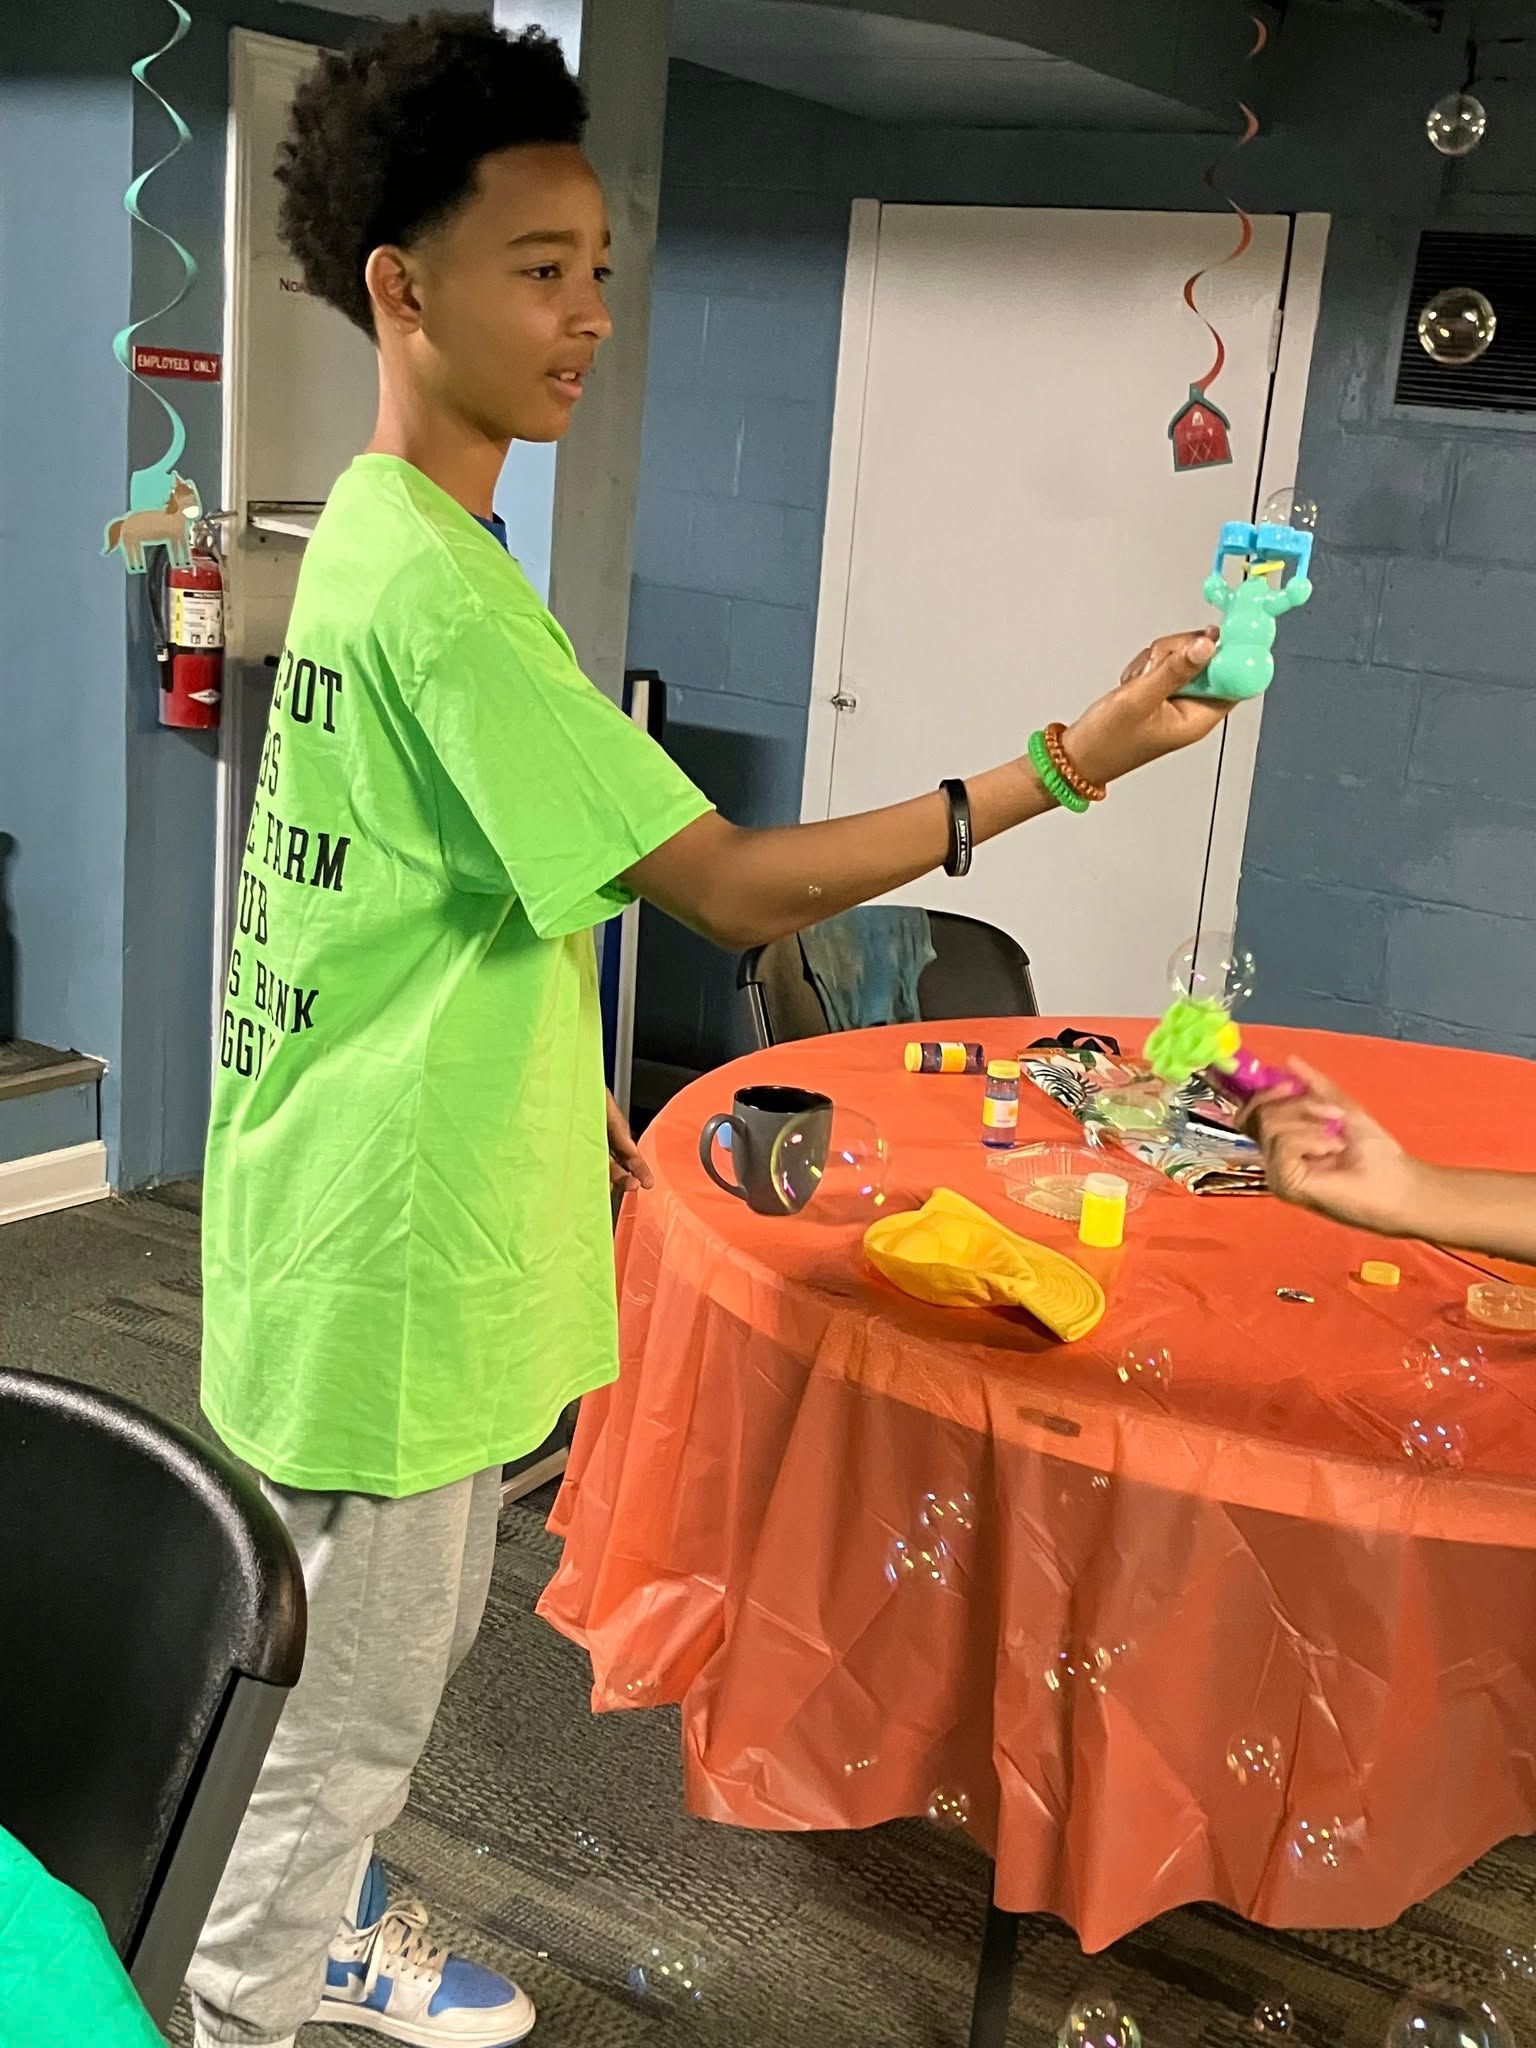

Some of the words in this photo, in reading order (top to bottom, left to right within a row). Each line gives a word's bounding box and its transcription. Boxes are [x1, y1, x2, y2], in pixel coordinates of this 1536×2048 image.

[137, 354, 190, 371] EMPLOYEES
[193, 360, 217, 373] ONLY
[263, 811, 351, 892] FARM
[229, 949, 241, 997] S
[255, 959, 320, 1034] BANK
